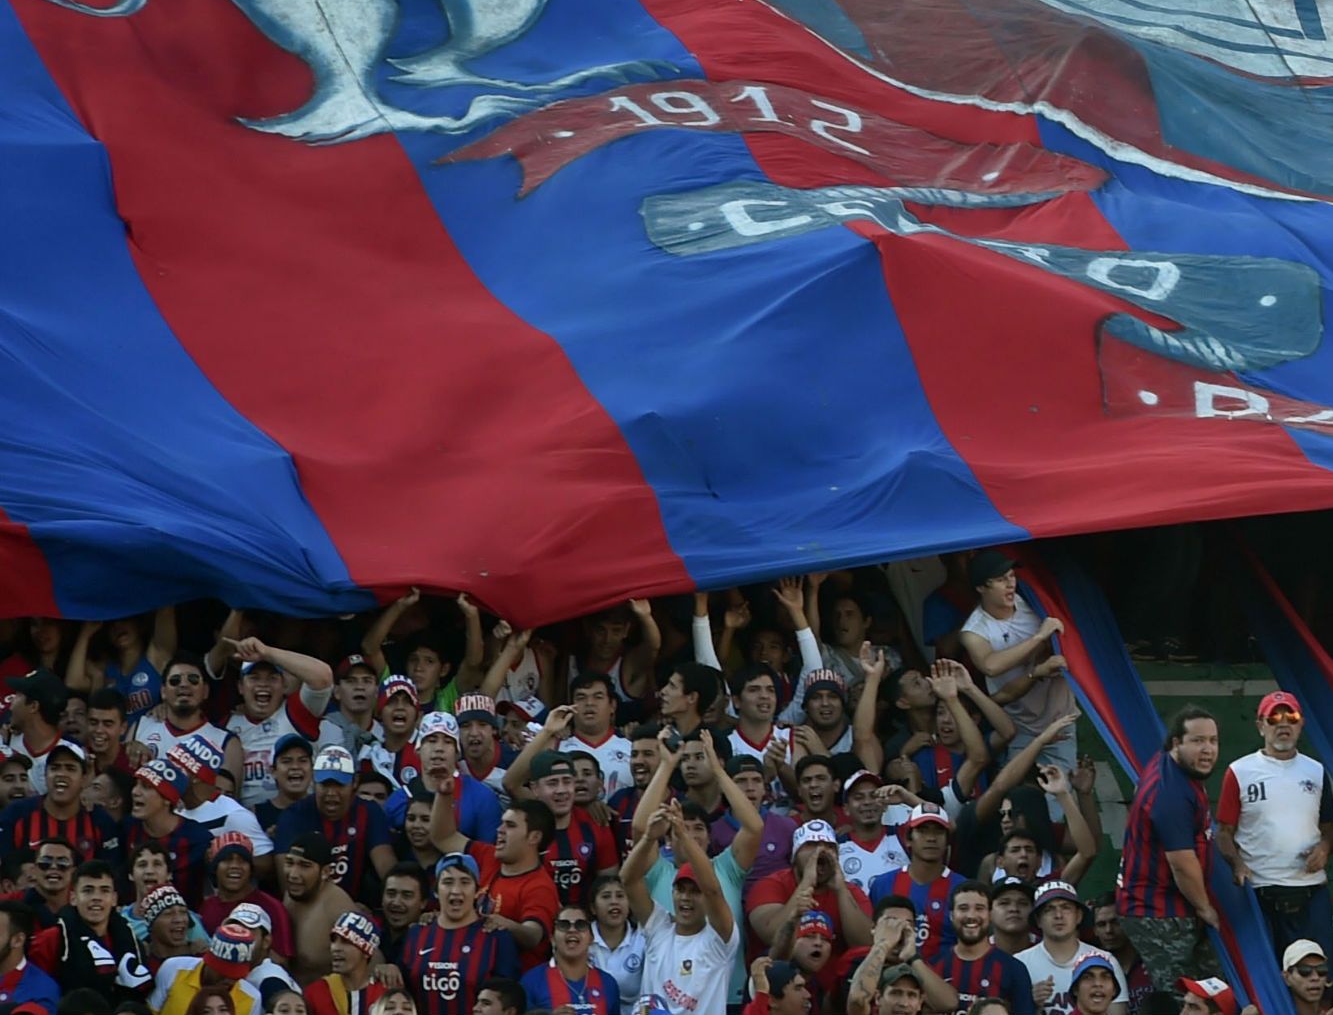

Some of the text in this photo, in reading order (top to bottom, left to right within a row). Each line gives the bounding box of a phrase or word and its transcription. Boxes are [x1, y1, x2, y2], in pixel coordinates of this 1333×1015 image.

[609, 86, 874, 156] 1912
[1246, 782, 1268, 803] 91
[422, 971, 461, 992] tigo
